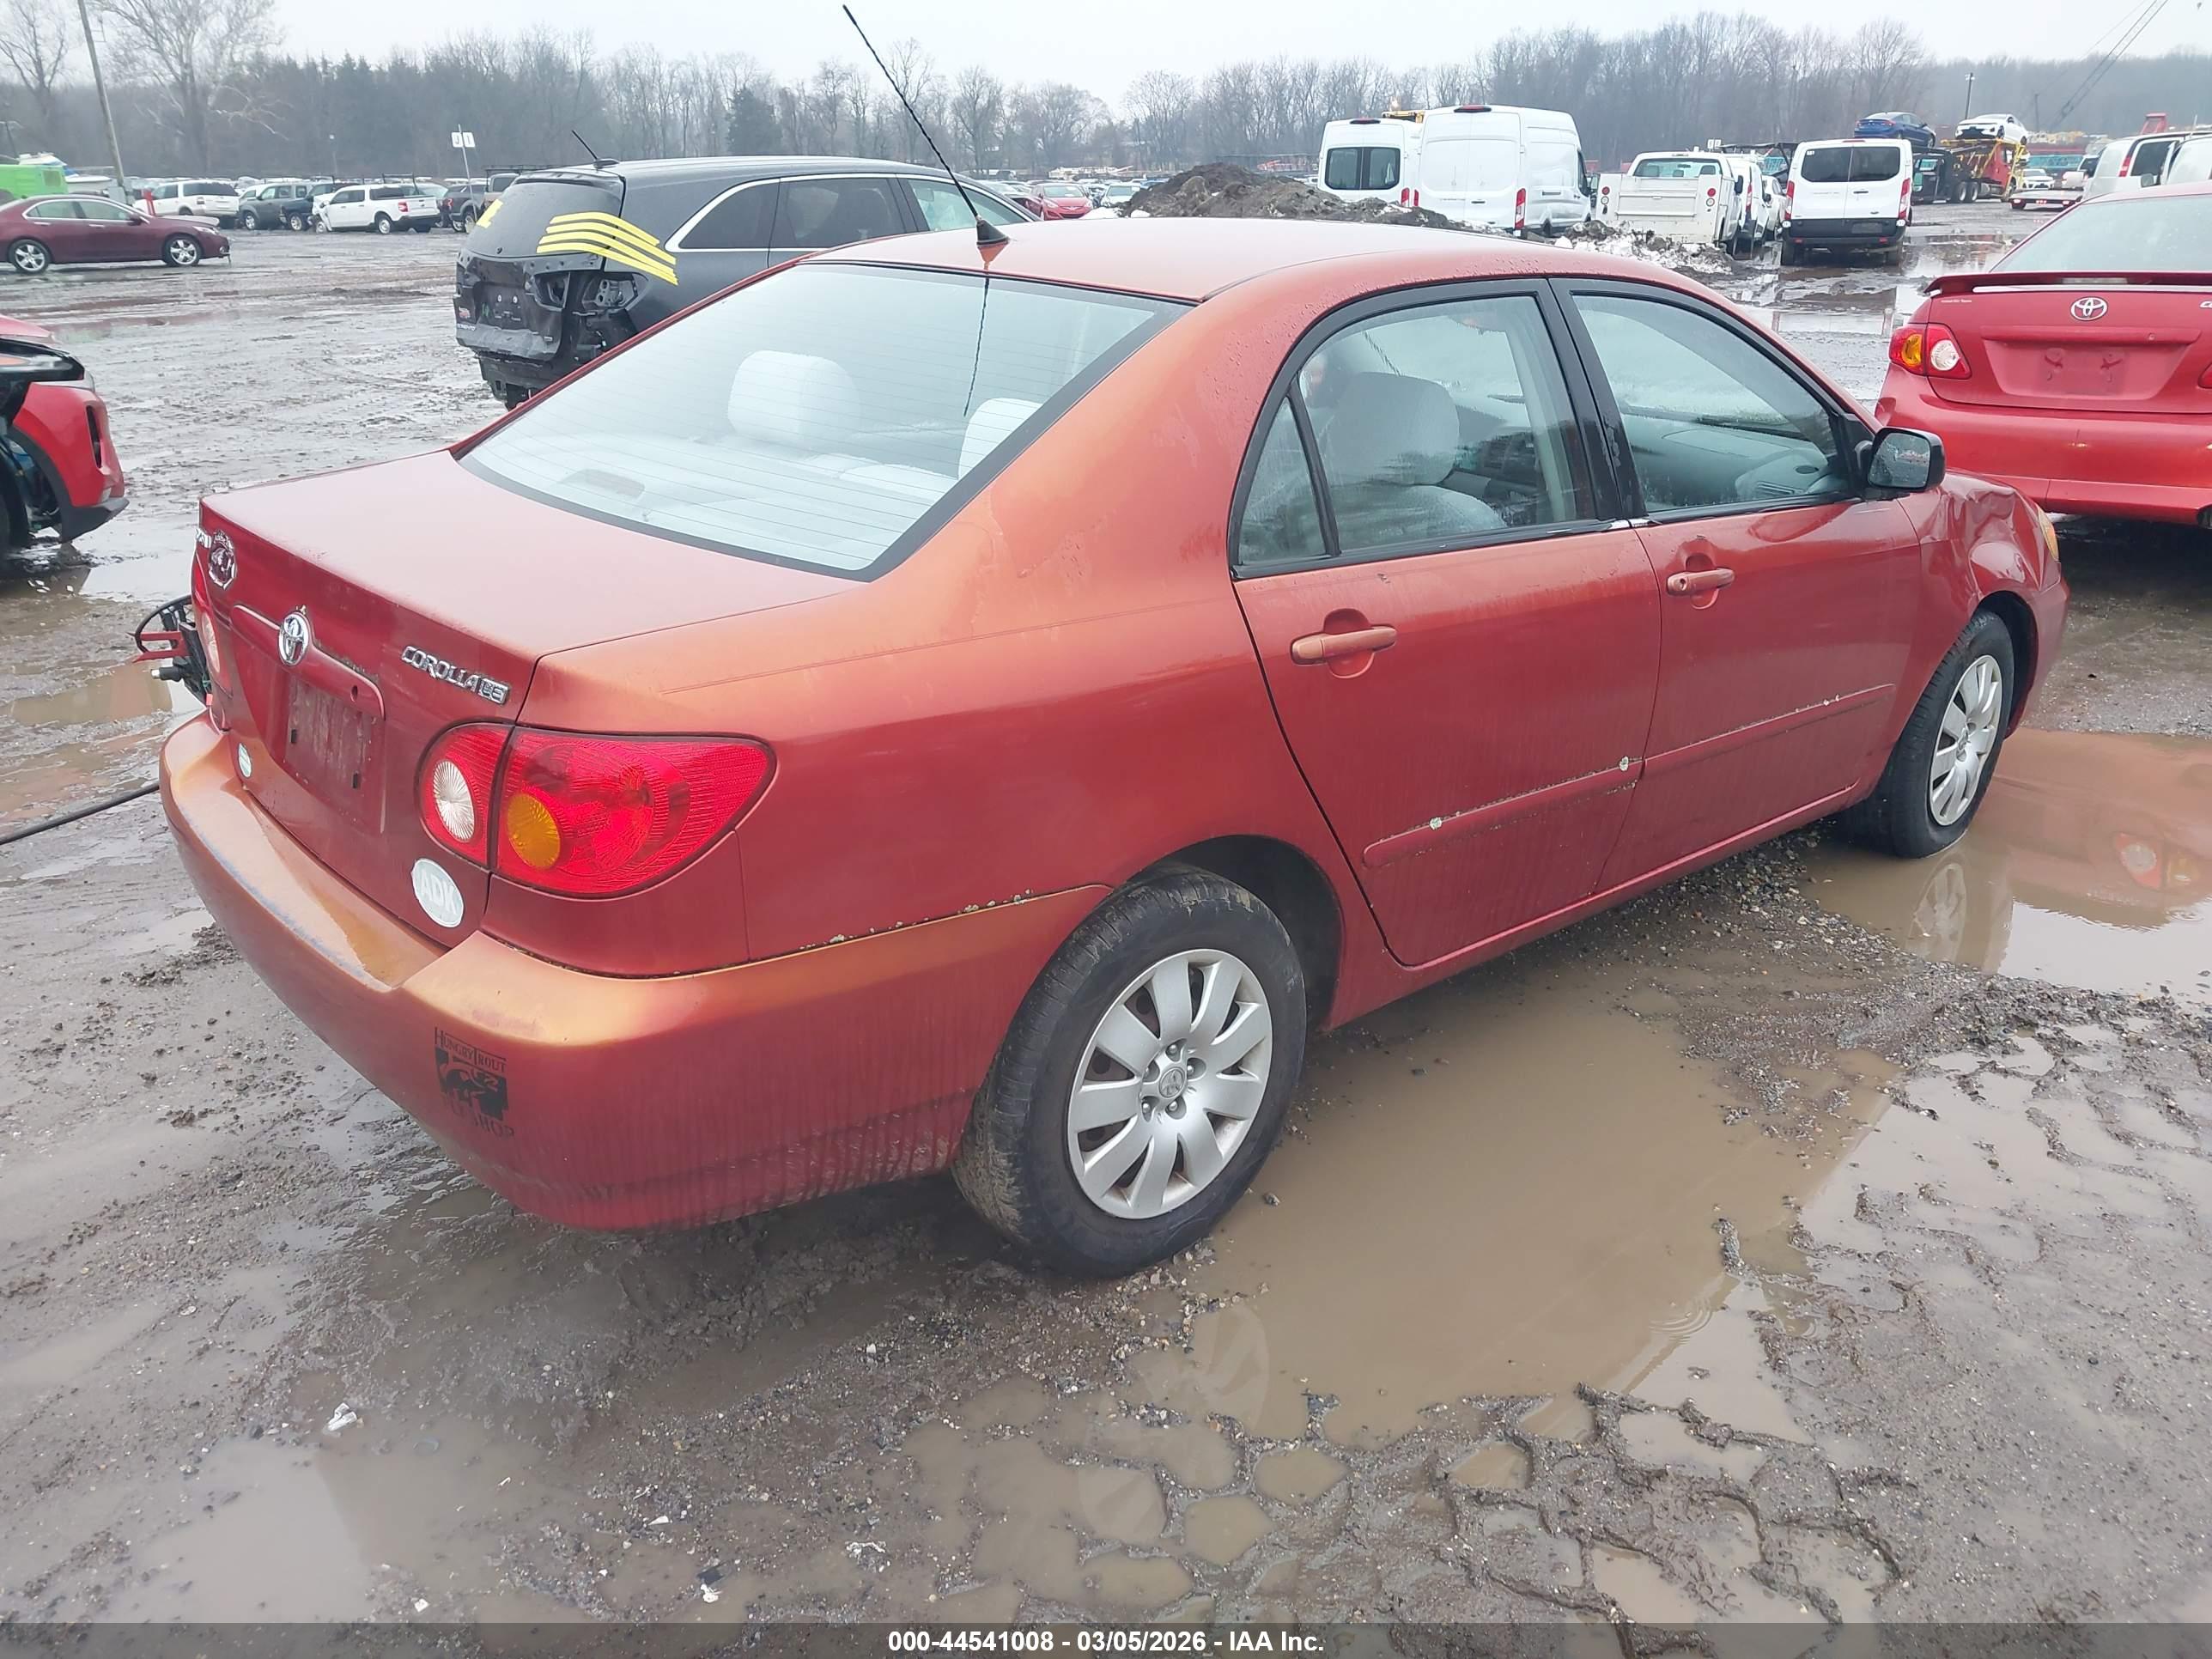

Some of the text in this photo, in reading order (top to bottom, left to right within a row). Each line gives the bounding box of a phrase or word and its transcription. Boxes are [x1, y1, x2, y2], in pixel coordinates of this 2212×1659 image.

[402, 646, 510, 704] COROLLA LE
[420, 867, 458, 915] ADK
